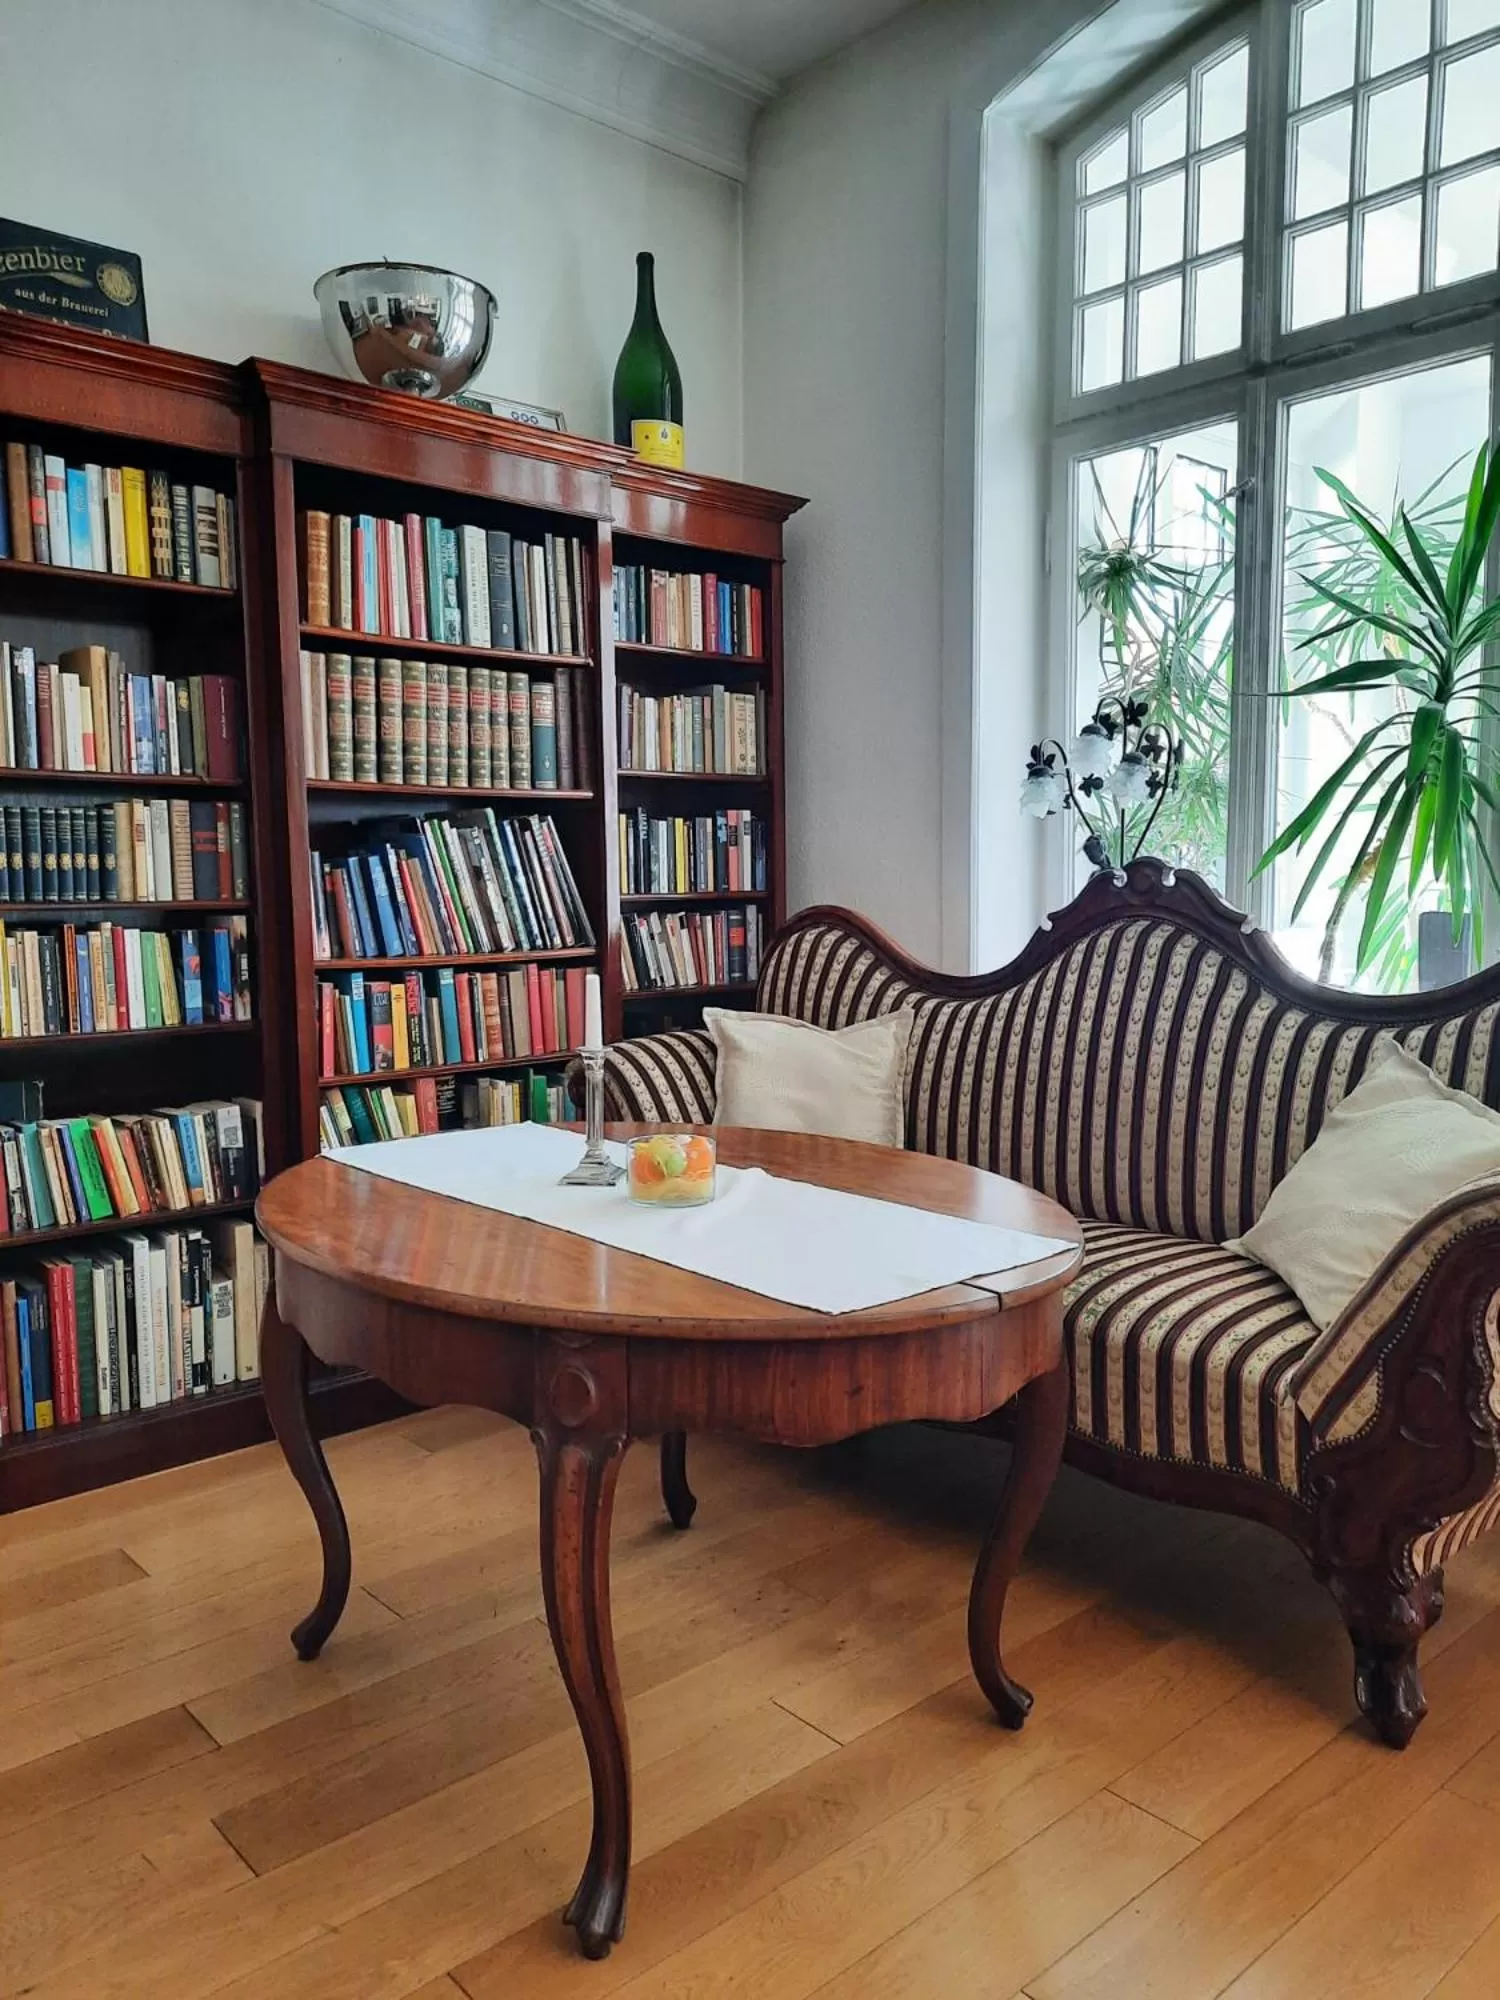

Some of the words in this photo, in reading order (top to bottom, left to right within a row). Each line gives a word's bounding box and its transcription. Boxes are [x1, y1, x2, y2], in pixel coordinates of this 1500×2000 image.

[14, 287, 35, 300] aus
[38, 291, 58, 306] der
[61, 297, 109, 318] Brauerei
